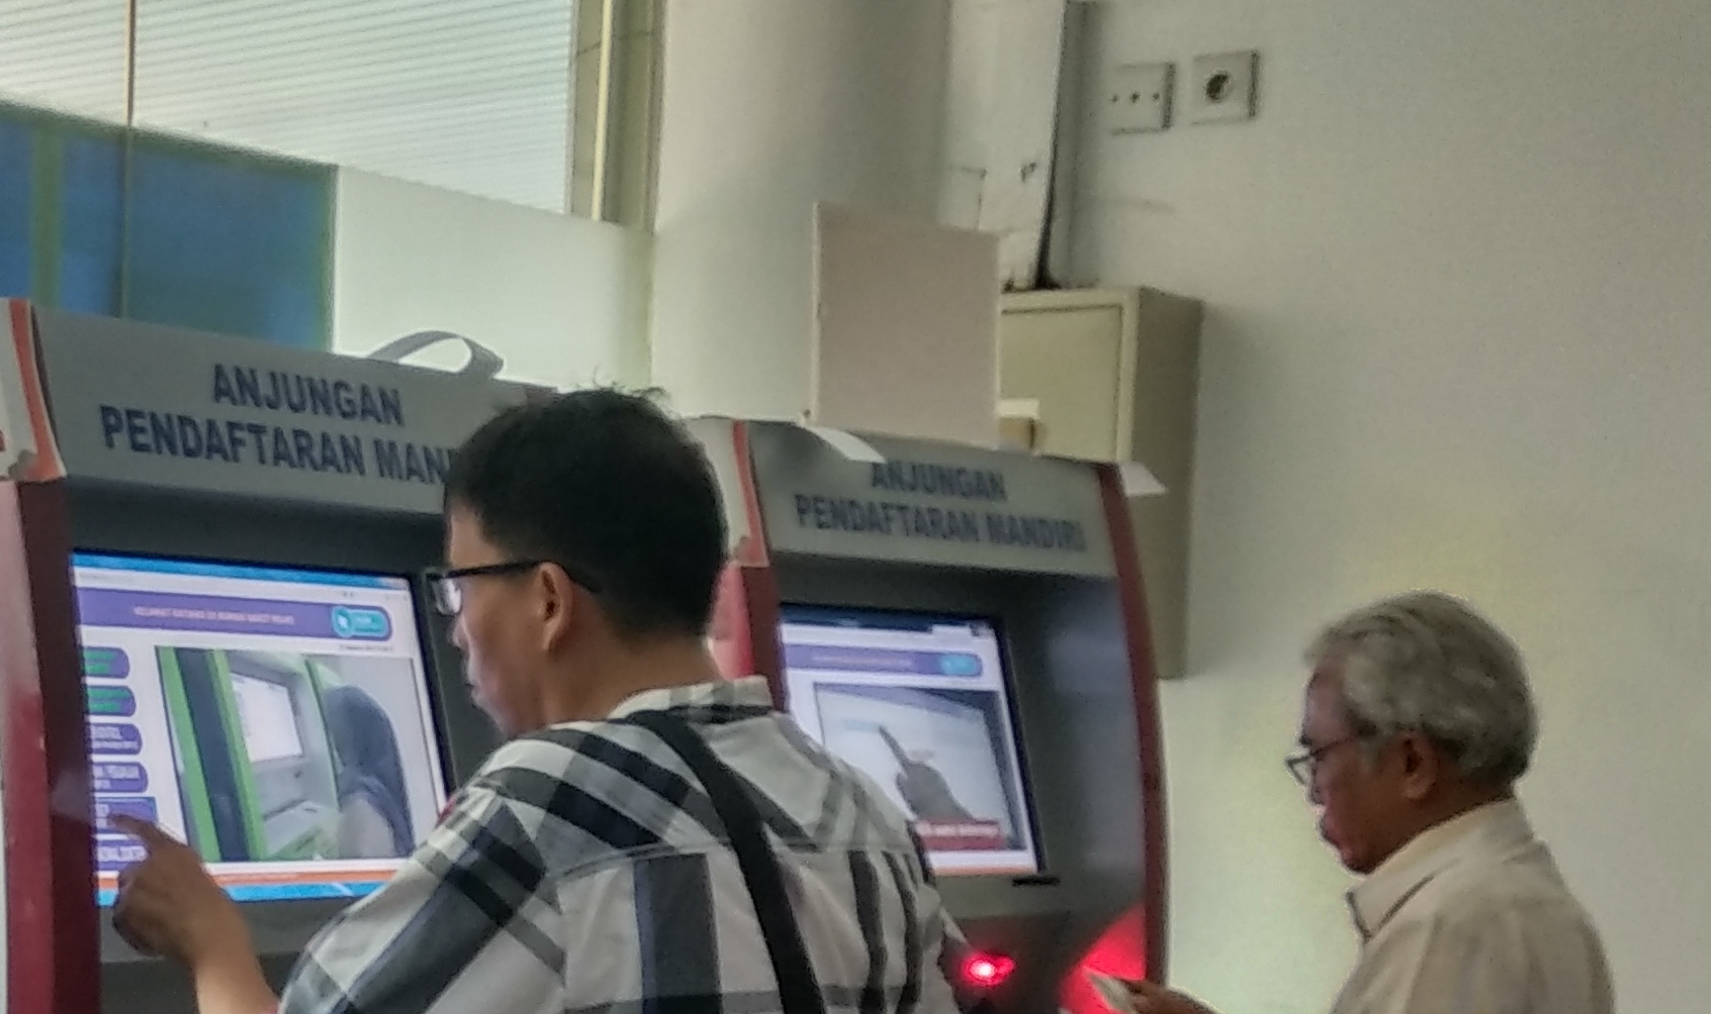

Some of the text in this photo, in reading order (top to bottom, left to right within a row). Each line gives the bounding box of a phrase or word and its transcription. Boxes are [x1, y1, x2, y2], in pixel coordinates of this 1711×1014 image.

[212, 363, 404, 428] ANJUNGAN
[99, 404, 451, 484] PENDAFTARAN MAN
[871, 460, 1008, 501] ANJUNGAN
[794, 493, 1087, 552] PENDAFTARAN MANDIRI
